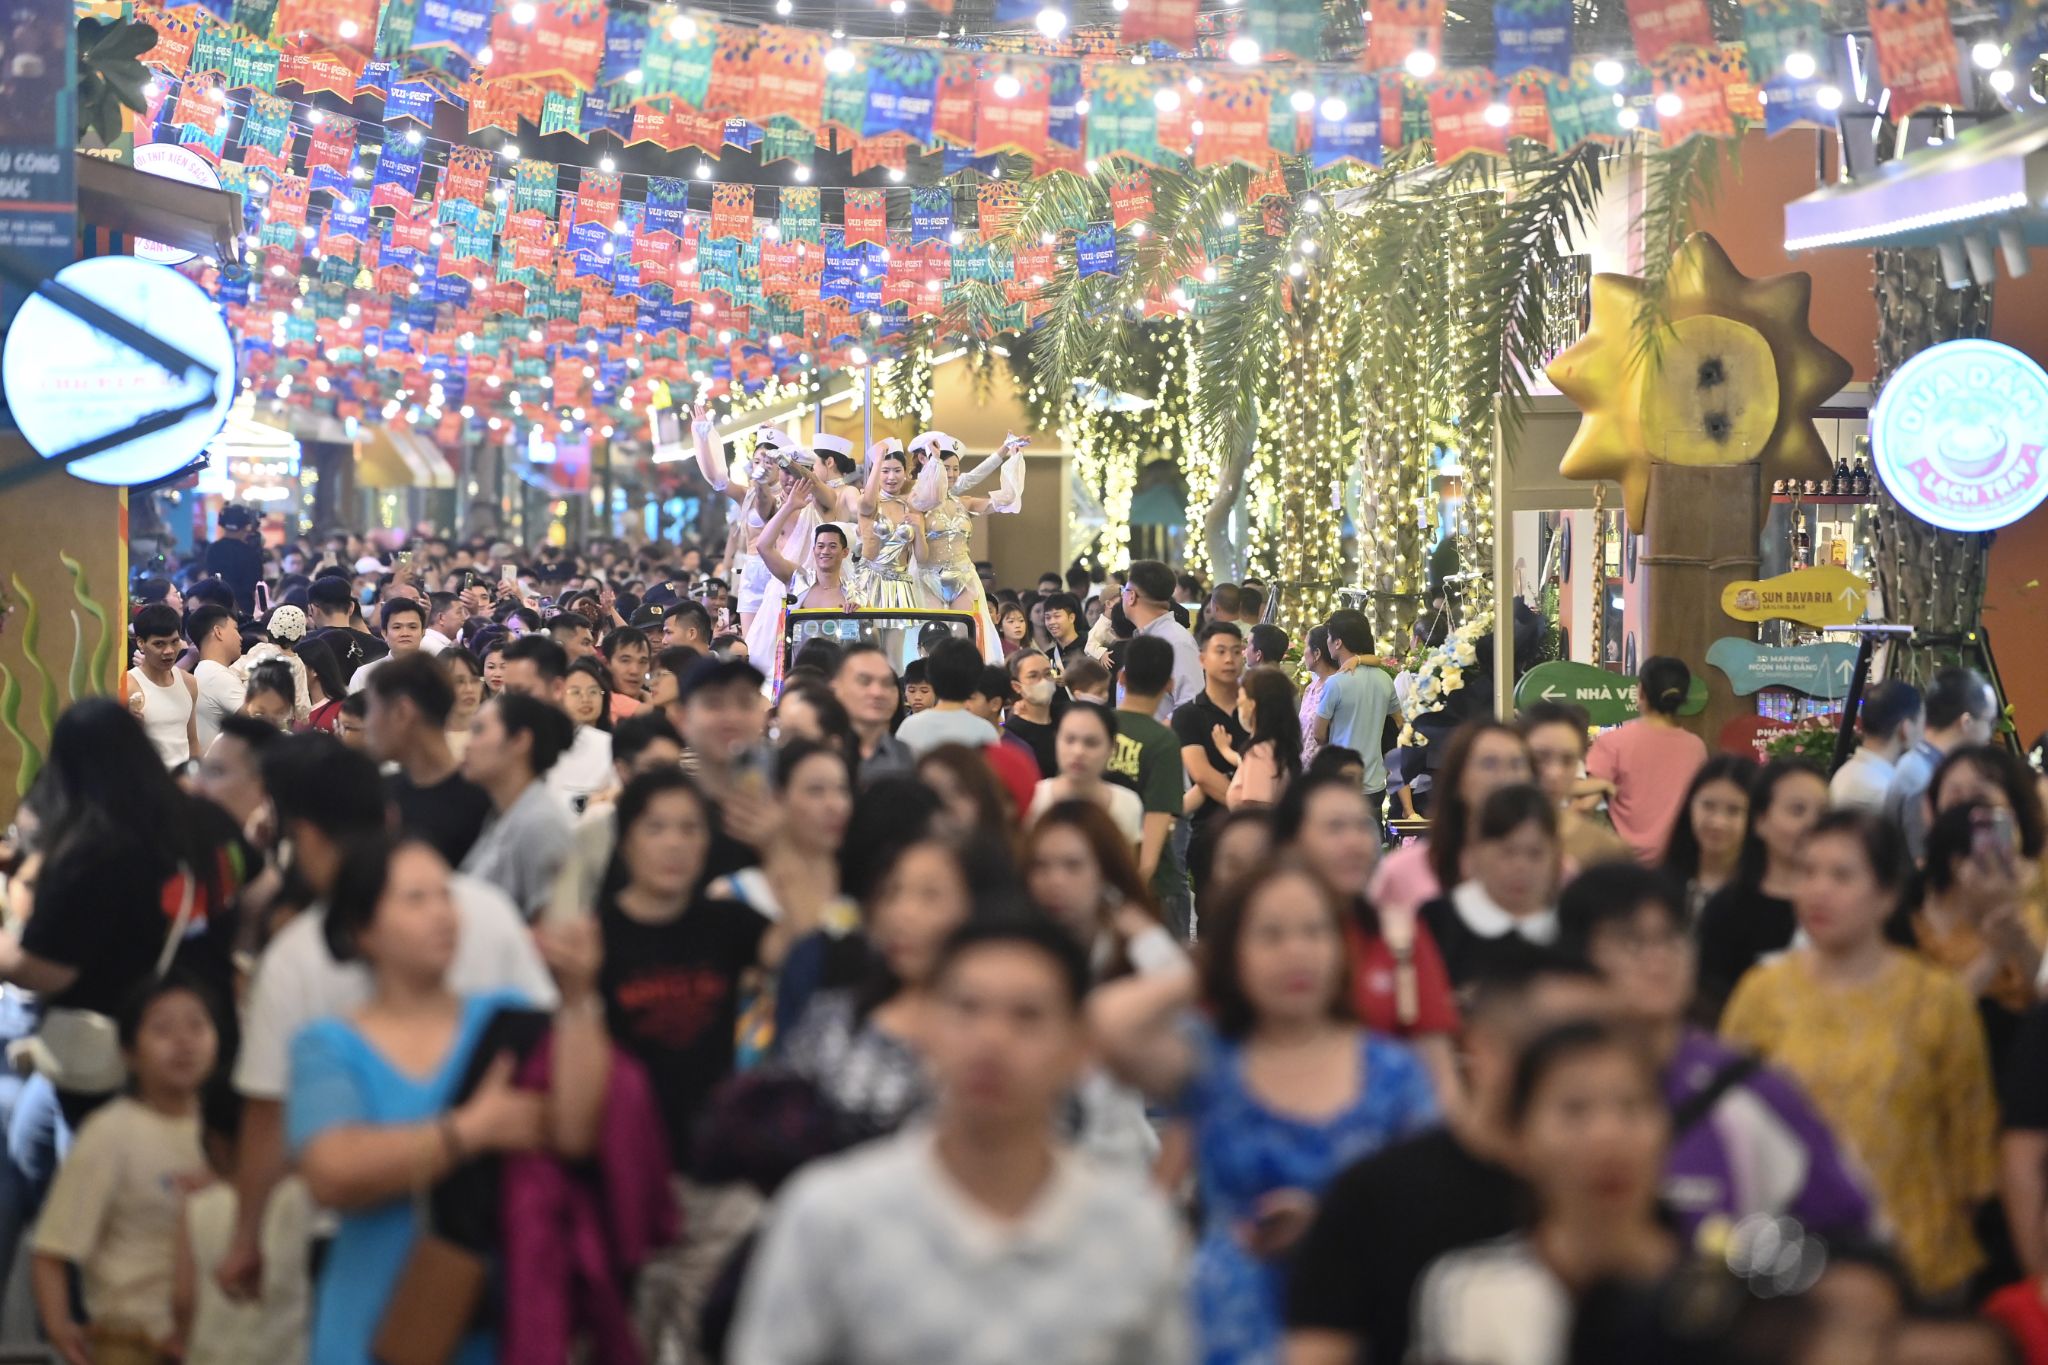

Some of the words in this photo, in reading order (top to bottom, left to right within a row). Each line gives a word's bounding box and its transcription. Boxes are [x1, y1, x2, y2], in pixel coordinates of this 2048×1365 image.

[1762, 592, 1782, 603] SUN
[1786, 592, 1833, 603] BAVARIA
[1576, 684, 1612, 700] NHÀ
